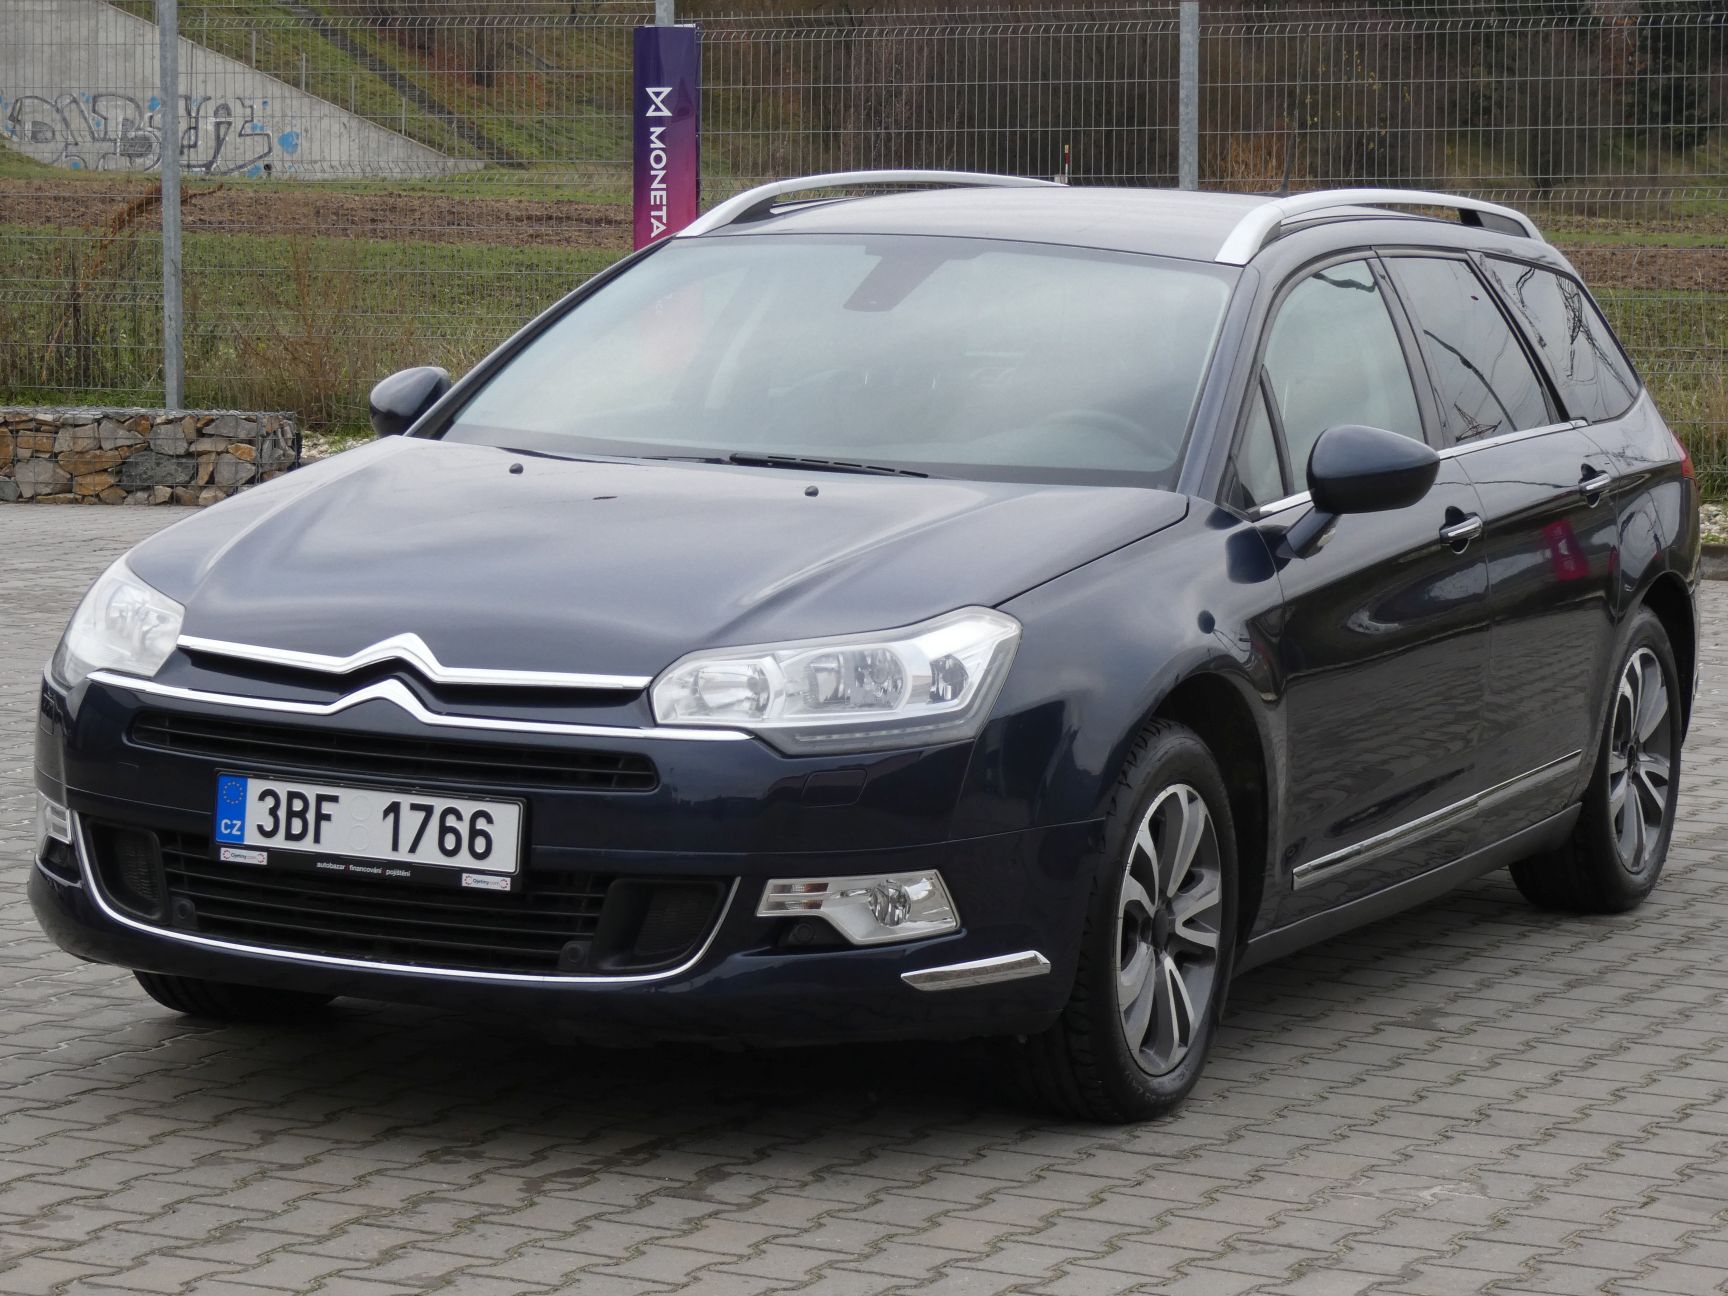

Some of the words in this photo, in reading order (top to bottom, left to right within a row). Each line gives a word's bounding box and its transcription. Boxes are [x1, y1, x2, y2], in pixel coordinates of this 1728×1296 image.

[649, 126, 667, 239] MONETA
[220, 819, 242, 836] CZ
[256, 788, 340, 845] 3BF
[382, 800, 495, 861] 1766
[316, 861, 346, 870] autobazar
